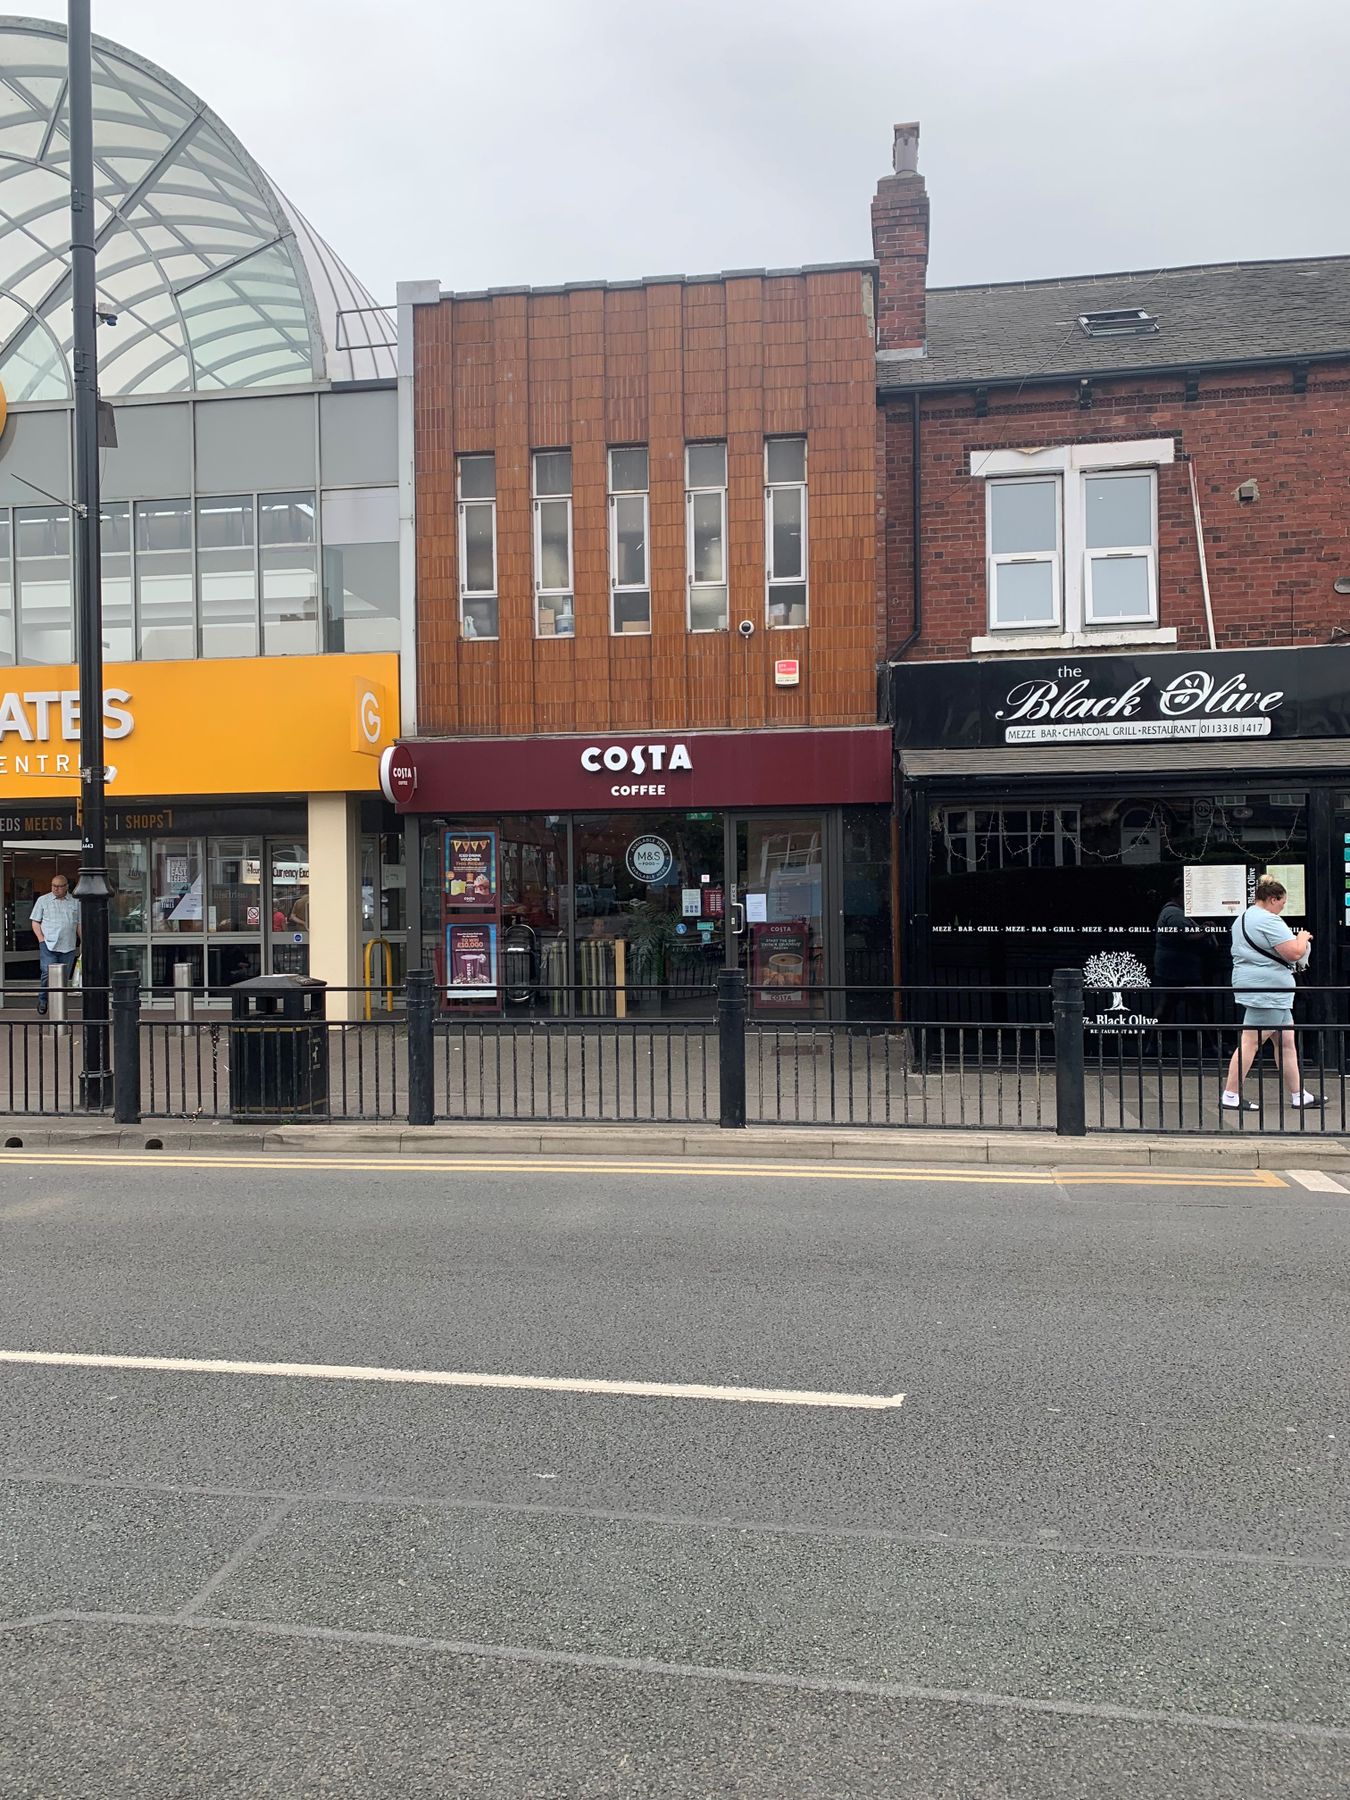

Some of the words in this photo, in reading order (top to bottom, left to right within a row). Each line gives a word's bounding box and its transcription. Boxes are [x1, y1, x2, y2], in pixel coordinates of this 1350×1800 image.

[1057, 665, 1082, 678] the
[994, 676, 1151, 721] Black
[1159, 670, 1284, 717] Olive
[1008, 729, 1036, 739] MEZZE
[0, 753, 82, 775] ENTR
[580, 744, 694, 775] COSTA
[393, 767, 413, 779] COSTA
[610, 784, 666, 796] COFFEE
[25, 816, 63, 831] MEETS
[125, 814, 164, 829] SHOPS
[637, 851, 661, 861] M&S
[1096, 1014, 1126, 1025] Black
[1128, 1014, 1159, 1025] Olive
